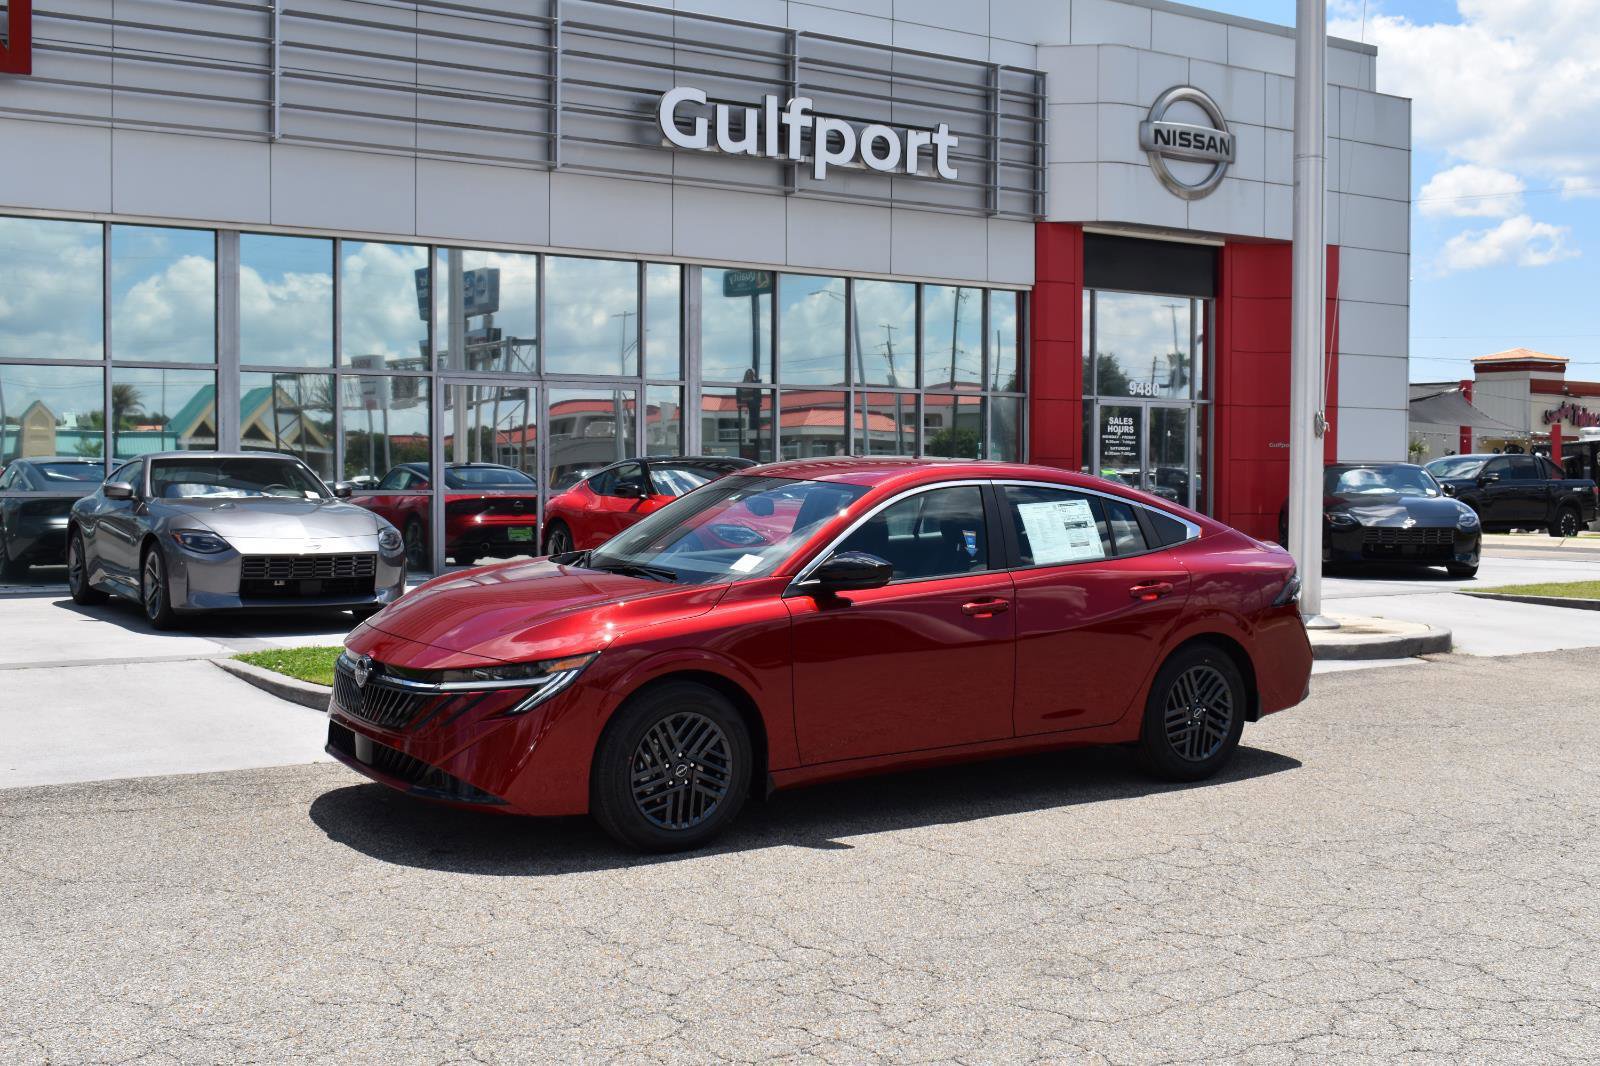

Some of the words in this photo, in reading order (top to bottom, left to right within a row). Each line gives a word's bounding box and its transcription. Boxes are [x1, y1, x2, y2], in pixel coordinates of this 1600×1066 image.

[657, 86, 959, 180] Gulfport
[1153, 128, 1230, 156] NISSAN
[1129, 381, 1160, 396] 9480
[1109, 417, 1133, 425] SALES
[1107, 425, 1134, 433] HOURS
